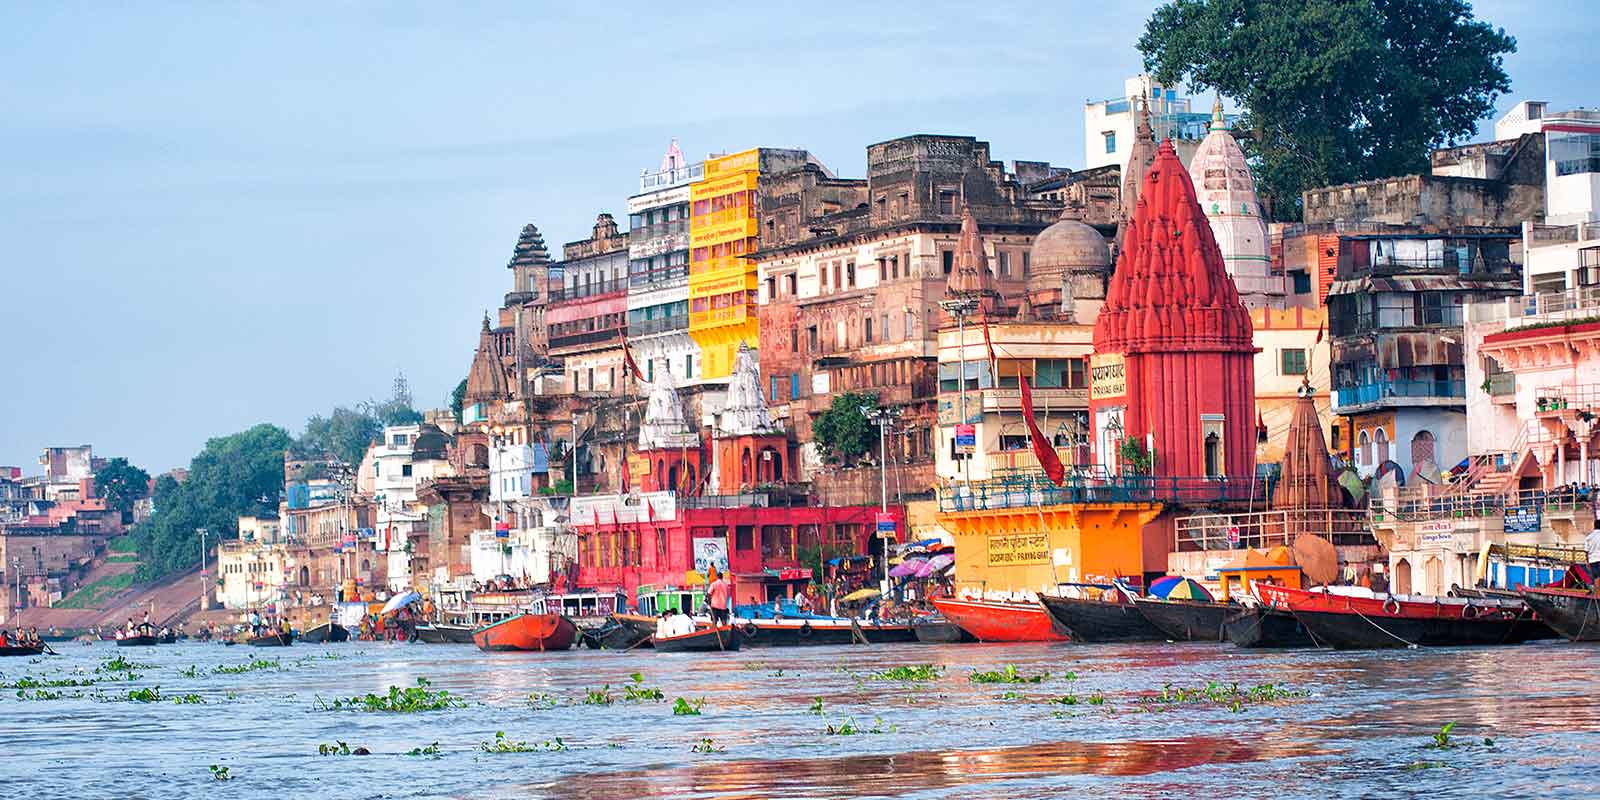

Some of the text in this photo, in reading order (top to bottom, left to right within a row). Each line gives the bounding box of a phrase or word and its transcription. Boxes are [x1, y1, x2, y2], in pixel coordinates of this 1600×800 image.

[1113, 383, 1125, 393] GHAT
[1017, 551, 1037, 561] PRAYAG
[1036, 550, 1049, 560] GHAT
